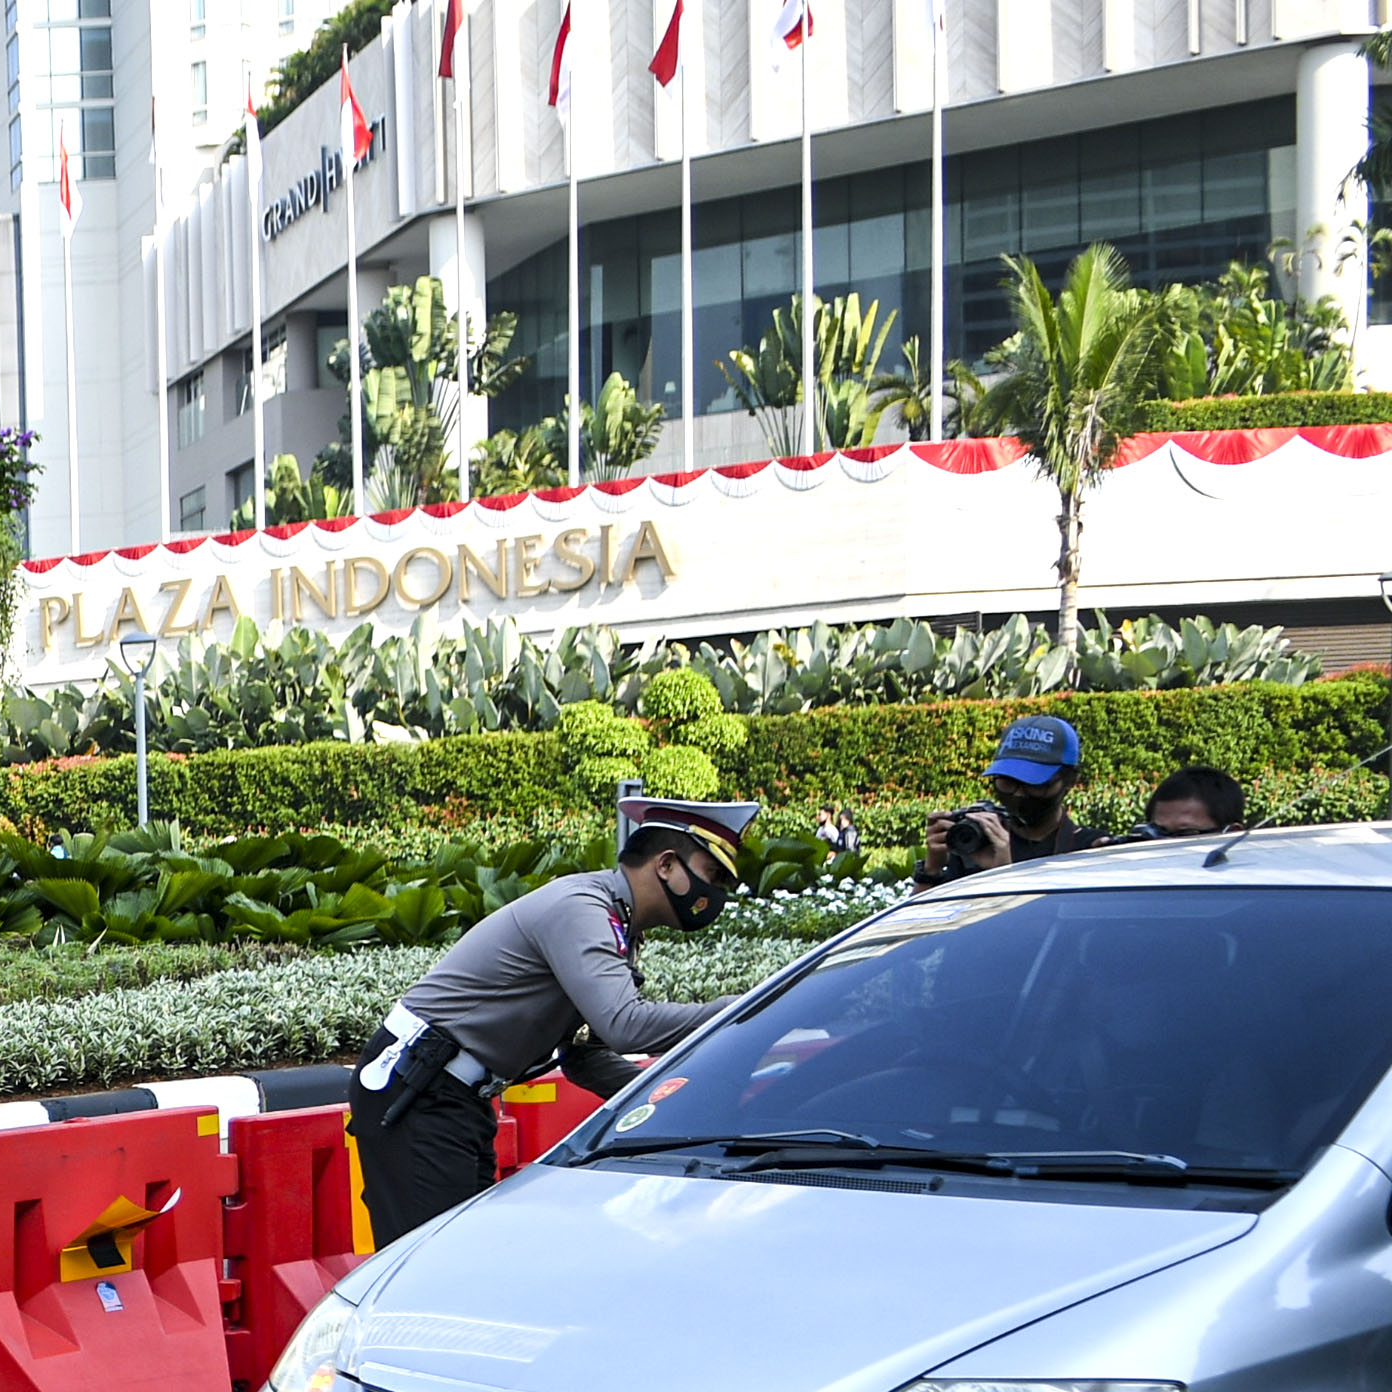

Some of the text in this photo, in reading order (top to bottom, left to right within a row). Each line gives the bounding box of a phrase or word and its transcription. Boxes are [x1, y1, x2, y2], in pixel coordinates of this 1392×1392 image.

[262, 112, 385, 241] GRAND HTT
[38, 520, 677, 651] PLAZA INDONESIA
